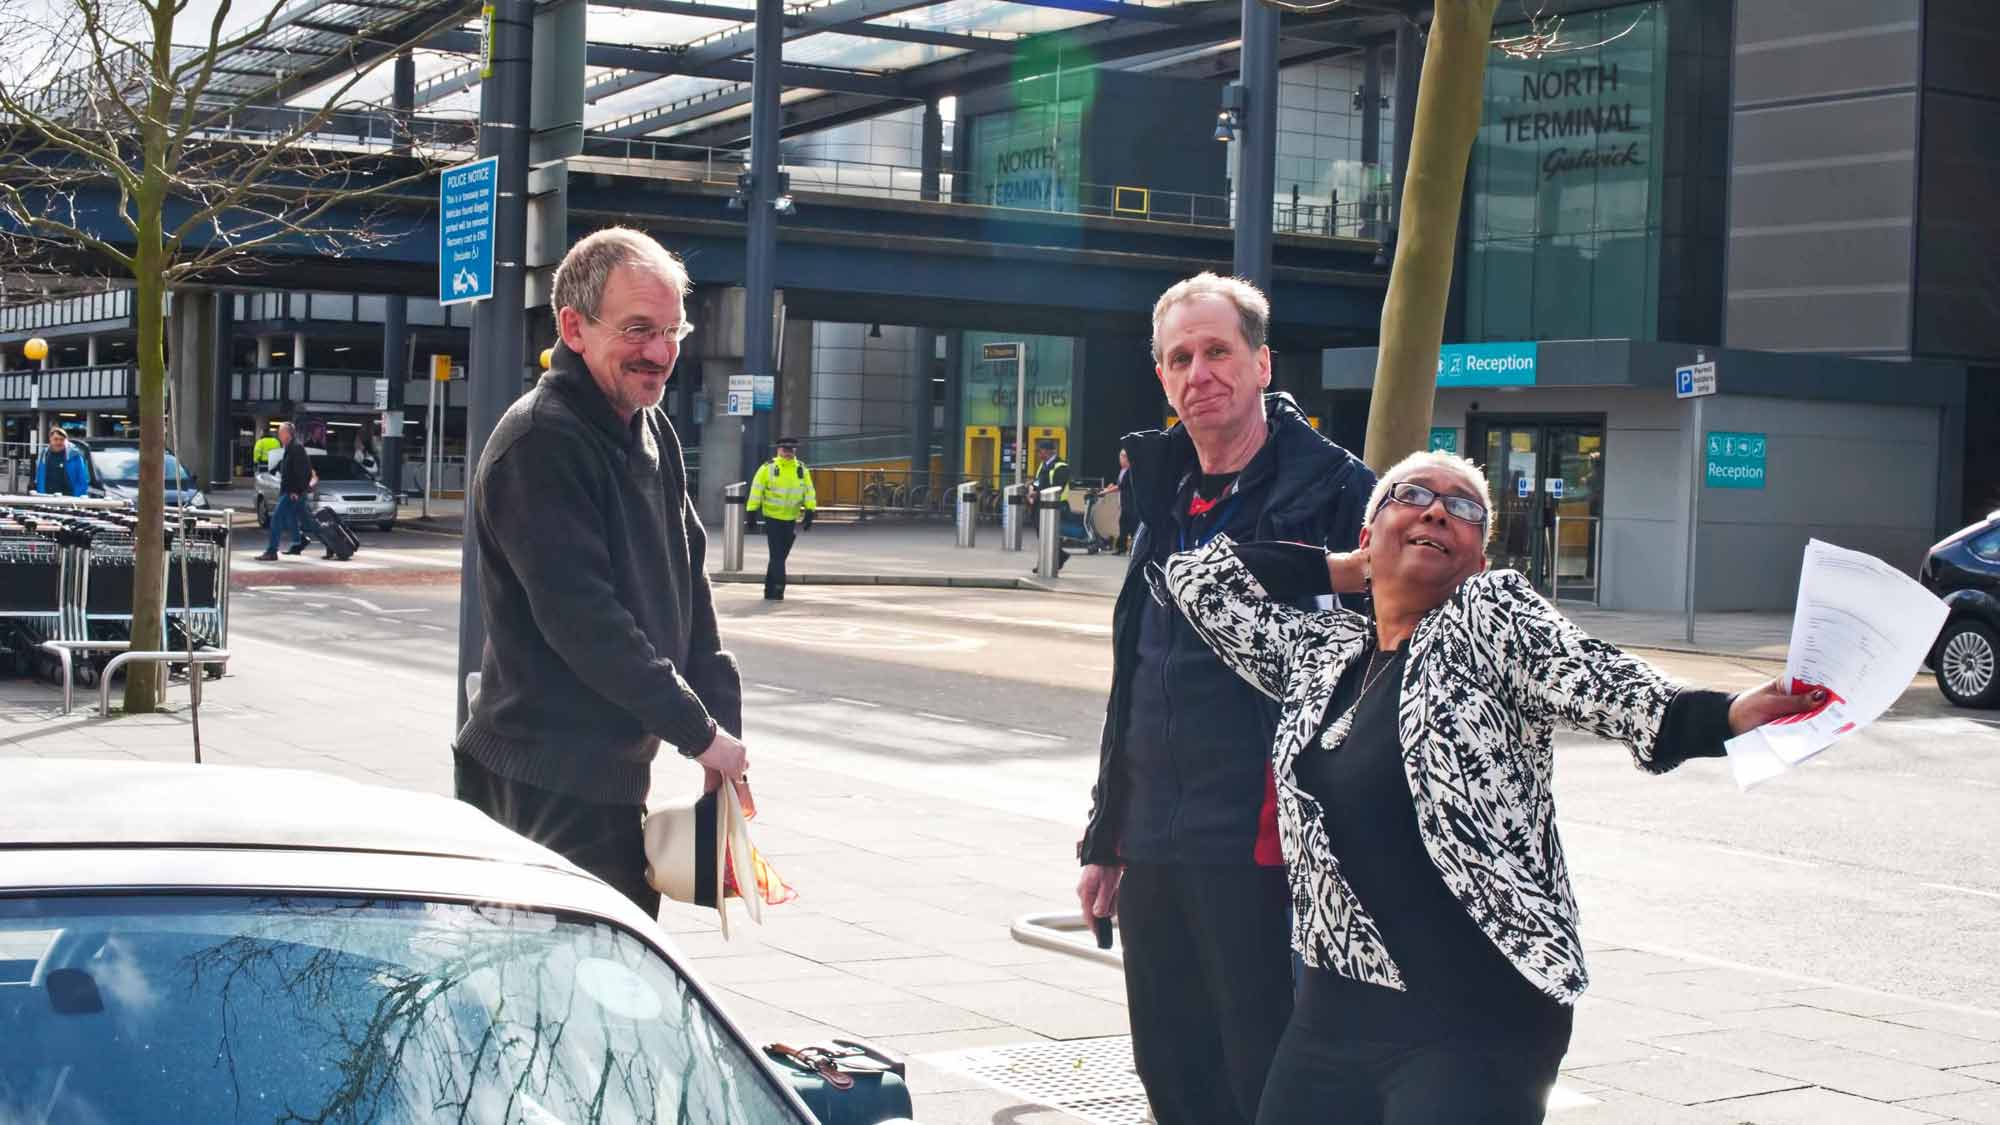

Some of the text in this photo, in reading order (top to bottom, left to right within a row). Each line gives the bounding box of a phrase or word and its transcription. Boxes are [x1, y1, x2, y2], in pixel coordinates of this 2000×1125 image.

[1522, 64, 1618, 102] NORTH
[1502, 103, 1640, 143] TERMINAL
[997, 145, 1056, 175] NORTH
[1542, 142, 1647, 181] Gatwick
[448, 167, 489, 188] POLICE NOTICE
[1466, 354, 1533, 373] Reception
[1682, 372, 1690, 391] P
[992, 385, 1066, 410] deprtures
[1708, 462, 1764, 481] Reception
